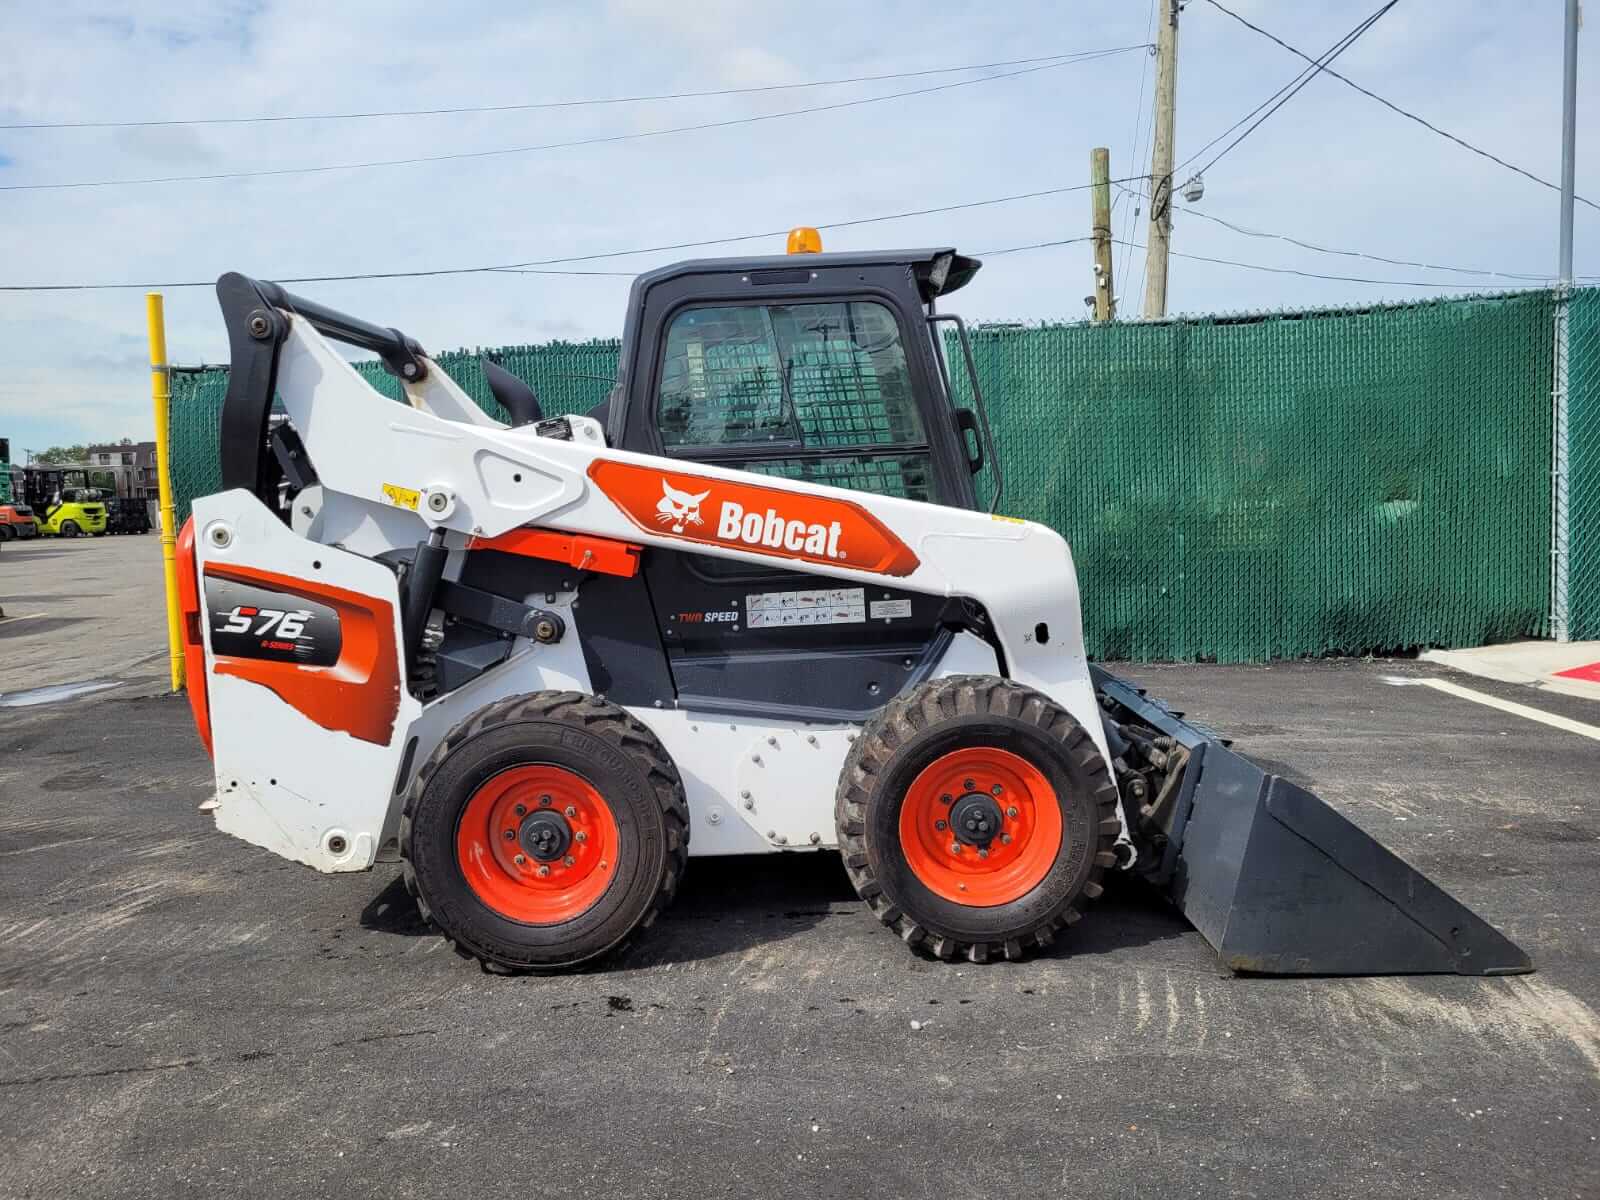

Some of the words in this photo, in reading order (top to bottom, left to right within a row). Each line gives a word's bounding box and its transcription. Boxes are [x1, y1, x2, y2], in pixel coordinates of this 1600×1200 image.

[717, 500, 842, 559] Bobcat
[222, 605, 311, 639] S76
[678, 612, 704, 623] TWO
[704, 611, 739, 623] SPEED
